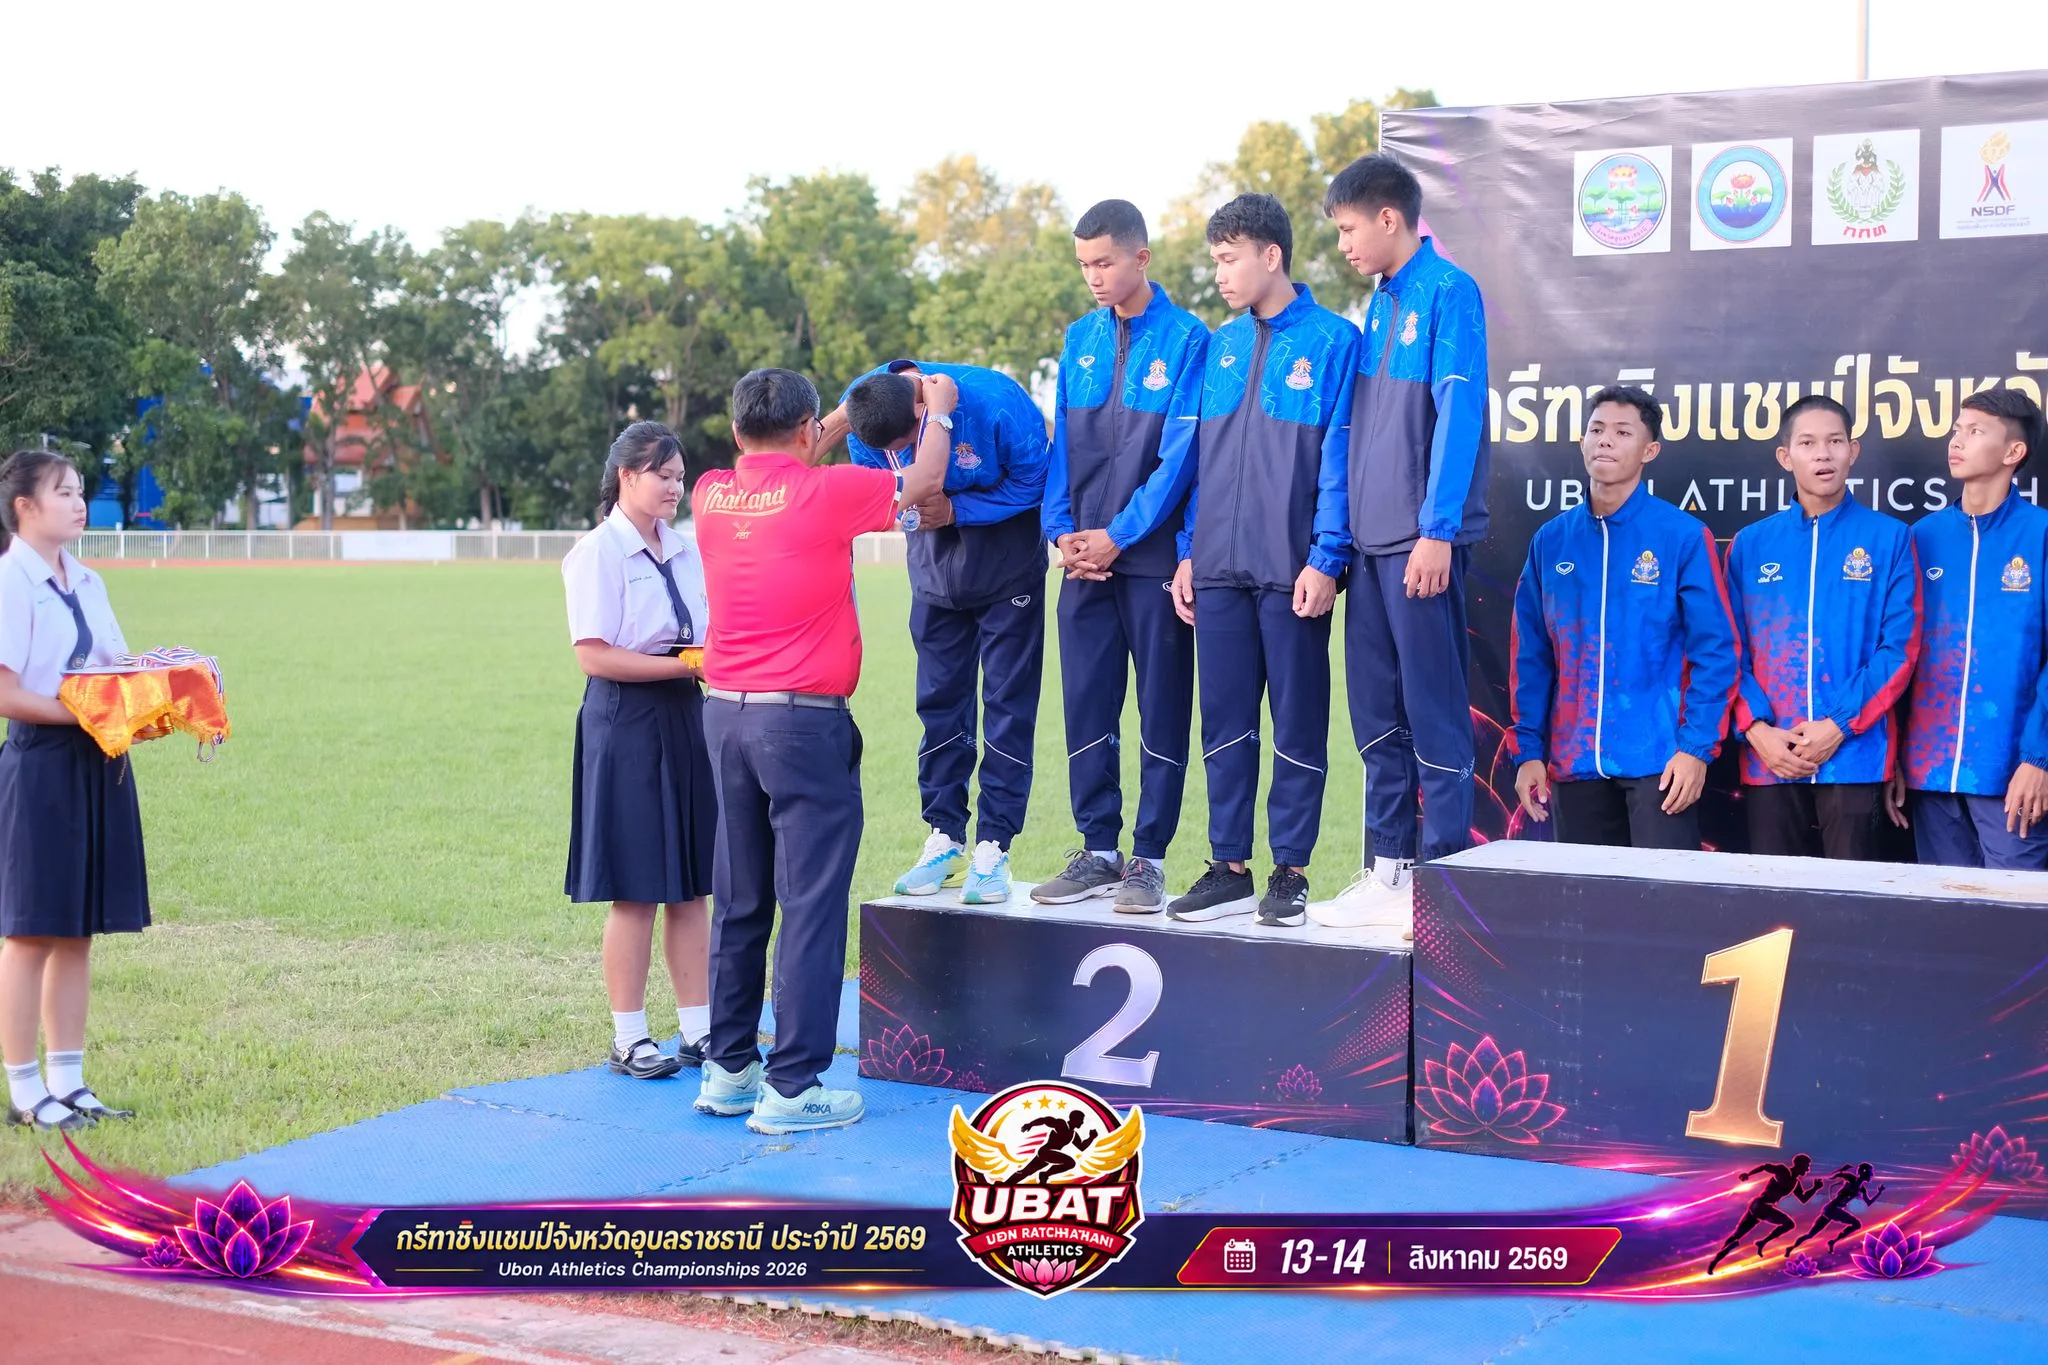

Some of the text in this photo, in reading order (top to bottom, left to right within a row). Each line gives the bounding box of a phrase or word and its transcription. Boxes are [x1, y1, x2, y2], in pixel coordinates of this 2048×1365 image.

[1971, 205, 2015, 217] NSDF
[702, 480, 788, 516] Thailand
[1525, 477, 1948, 512] UB ATHLTICS
[1061, 943, 1163, 1088] 2
[1685, 929, 1793, 1147] 1
[802, 1102, 832, 1114] HOKA
